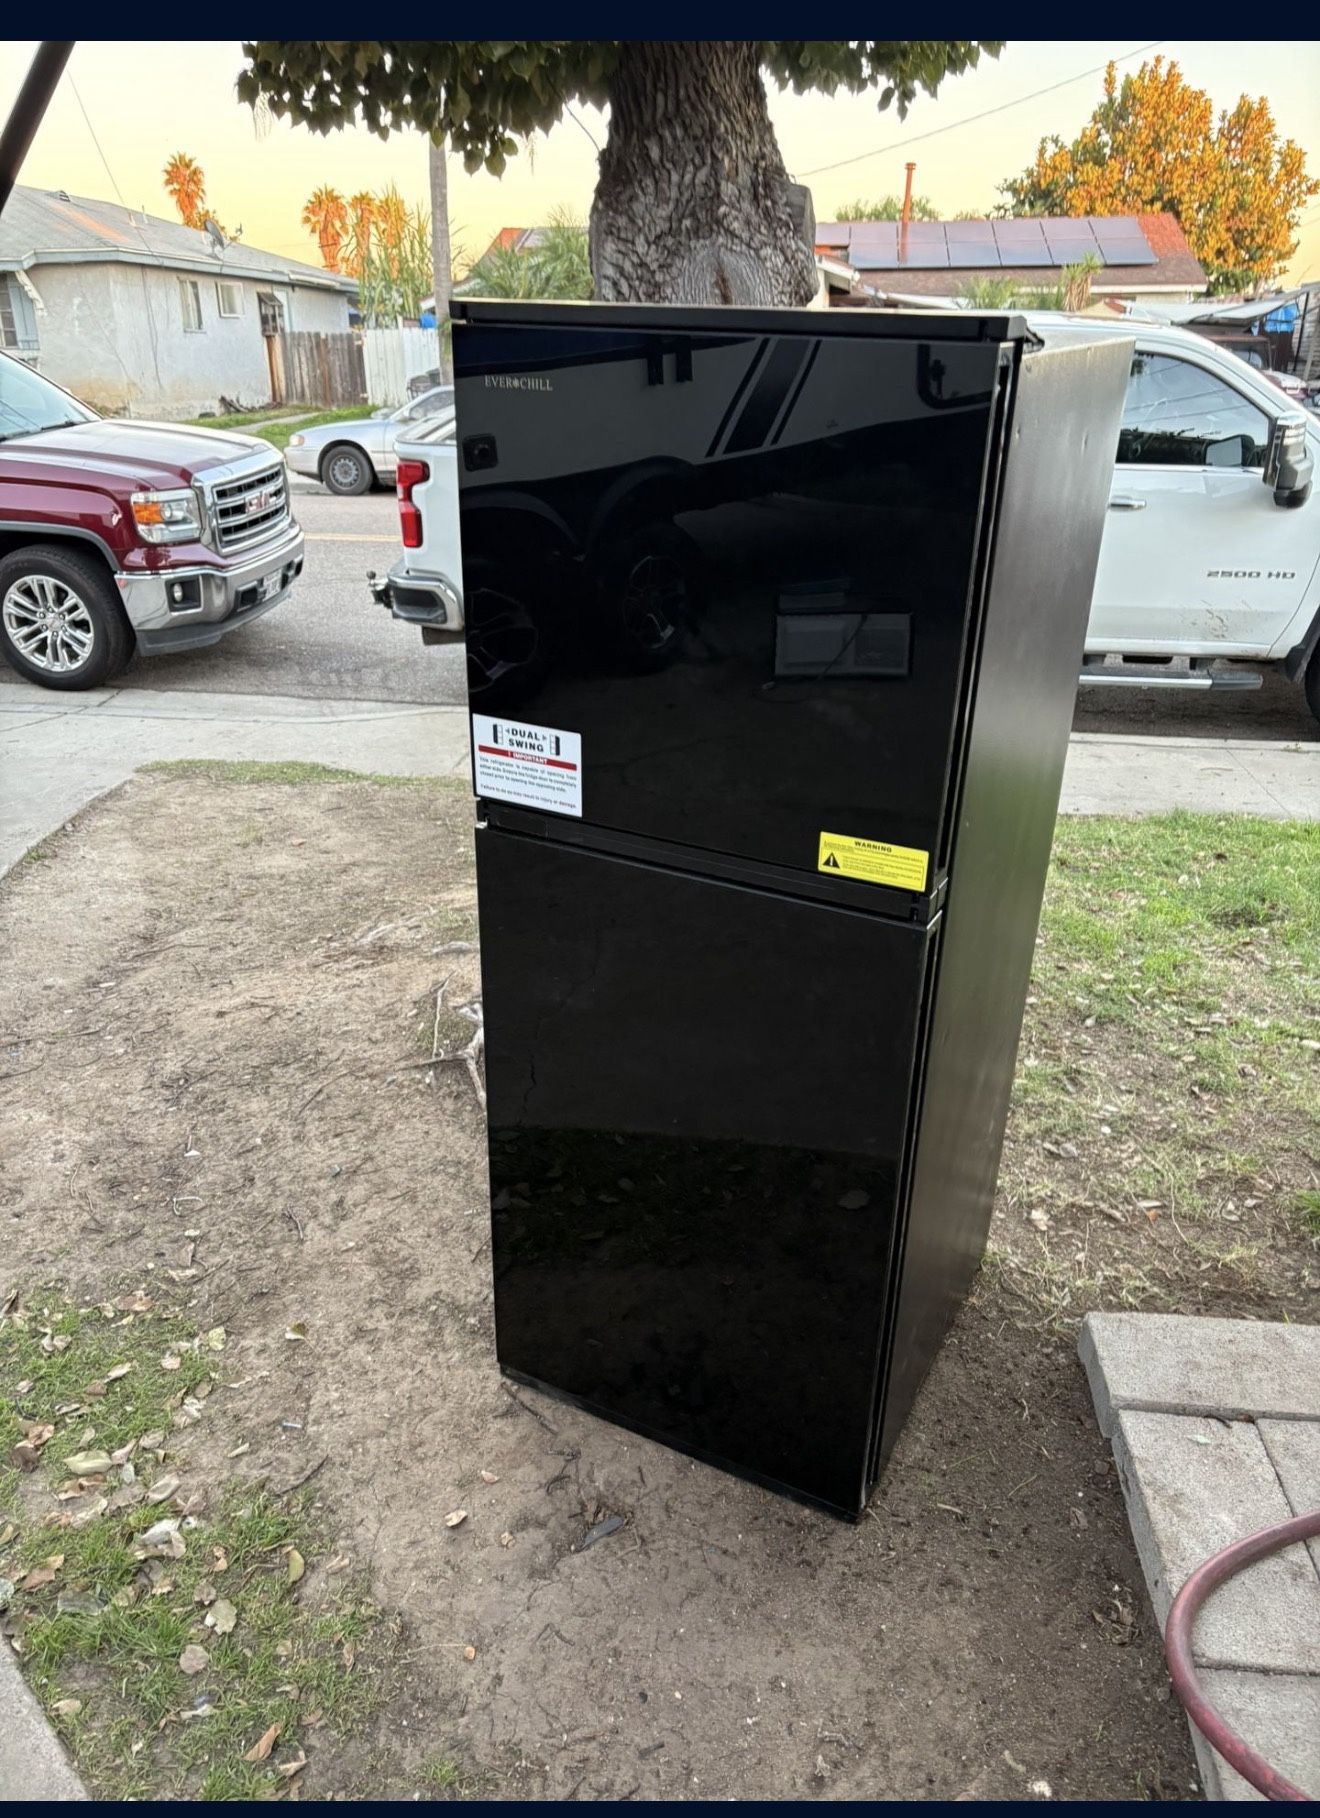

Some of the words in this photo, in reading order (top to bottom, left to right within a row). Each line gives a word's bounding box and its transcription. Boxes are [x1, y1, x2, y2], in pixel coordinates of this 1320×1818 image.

[1207, 570, 1260, 579] 2500
[1267, 570, 1295, 580] HD
[511, 728, 540, 741] DUAL
[508, 738, 544, 752] SWING
[854, 841, 892, 853] WARNING
